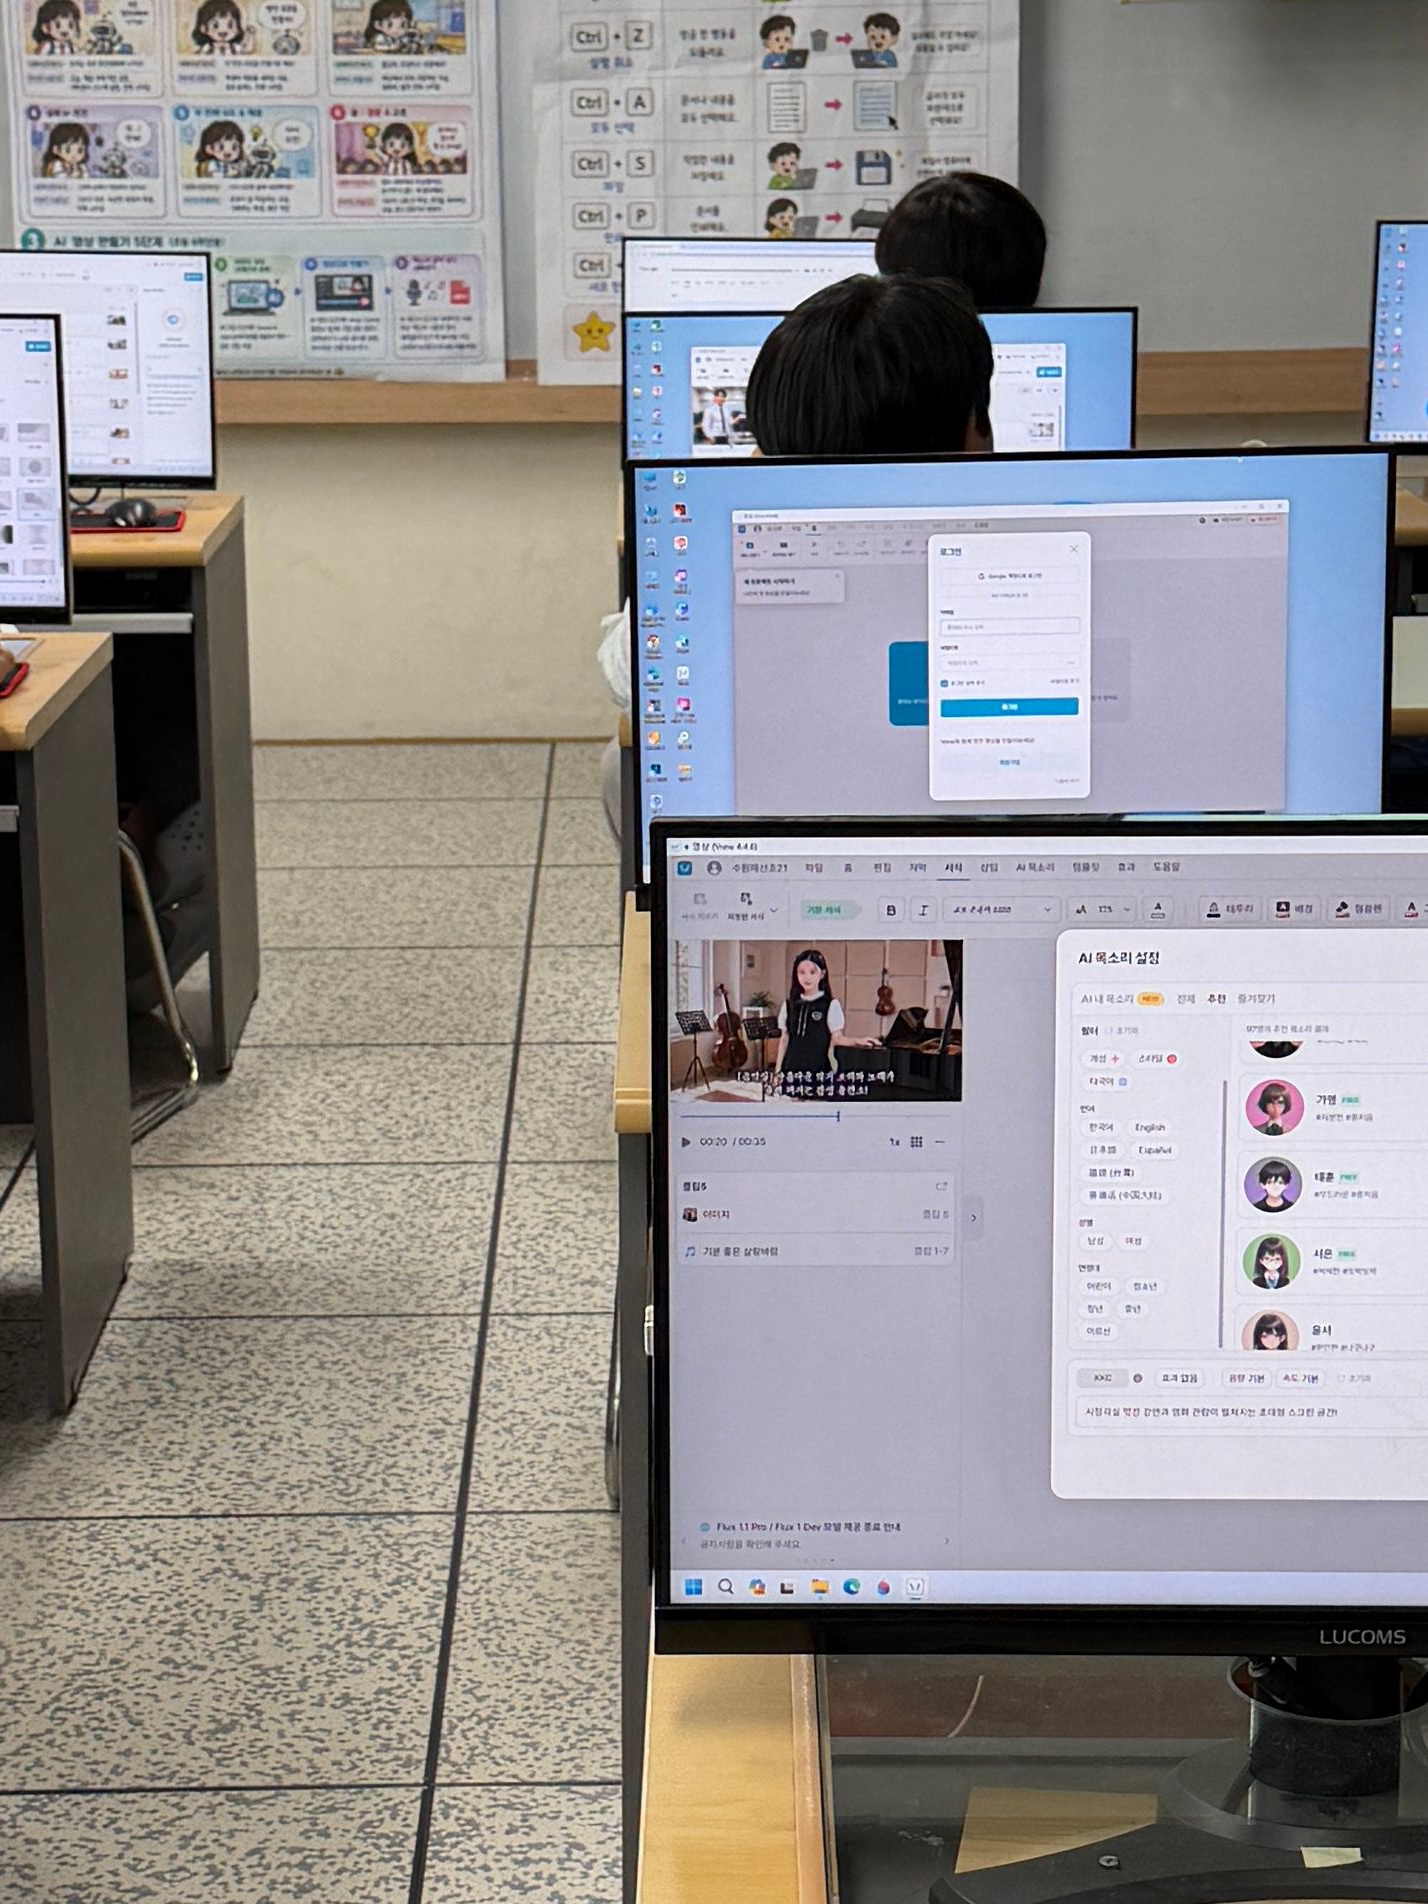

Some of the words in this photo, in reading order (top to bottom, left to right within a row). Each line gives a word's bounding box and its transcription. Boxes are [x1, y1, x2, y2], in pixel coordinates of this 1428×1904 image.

[576, 30, 602, 44] Ctrl
[632, 28, 644, 43] Z
[576, 96, 603, 110] Ctrl
[633, 95, 646, 109] A
[577, 157, 604, 172] Ctrl
[635, 156, 646, 171] S
[577, 209, 604, 224] Ctrl
[635, 208, 647, 223] P
[579, 259, 604, 273] Ctrl
[1078, 952, 1093, 965] AI
[1095, 951, 1133, 965] 목소리
[1135, 951, 1160, 965] 설정
[700, 1137, 728, 1147] 00:20
[1320, 1629, 1407, 1645] LUCOMS
